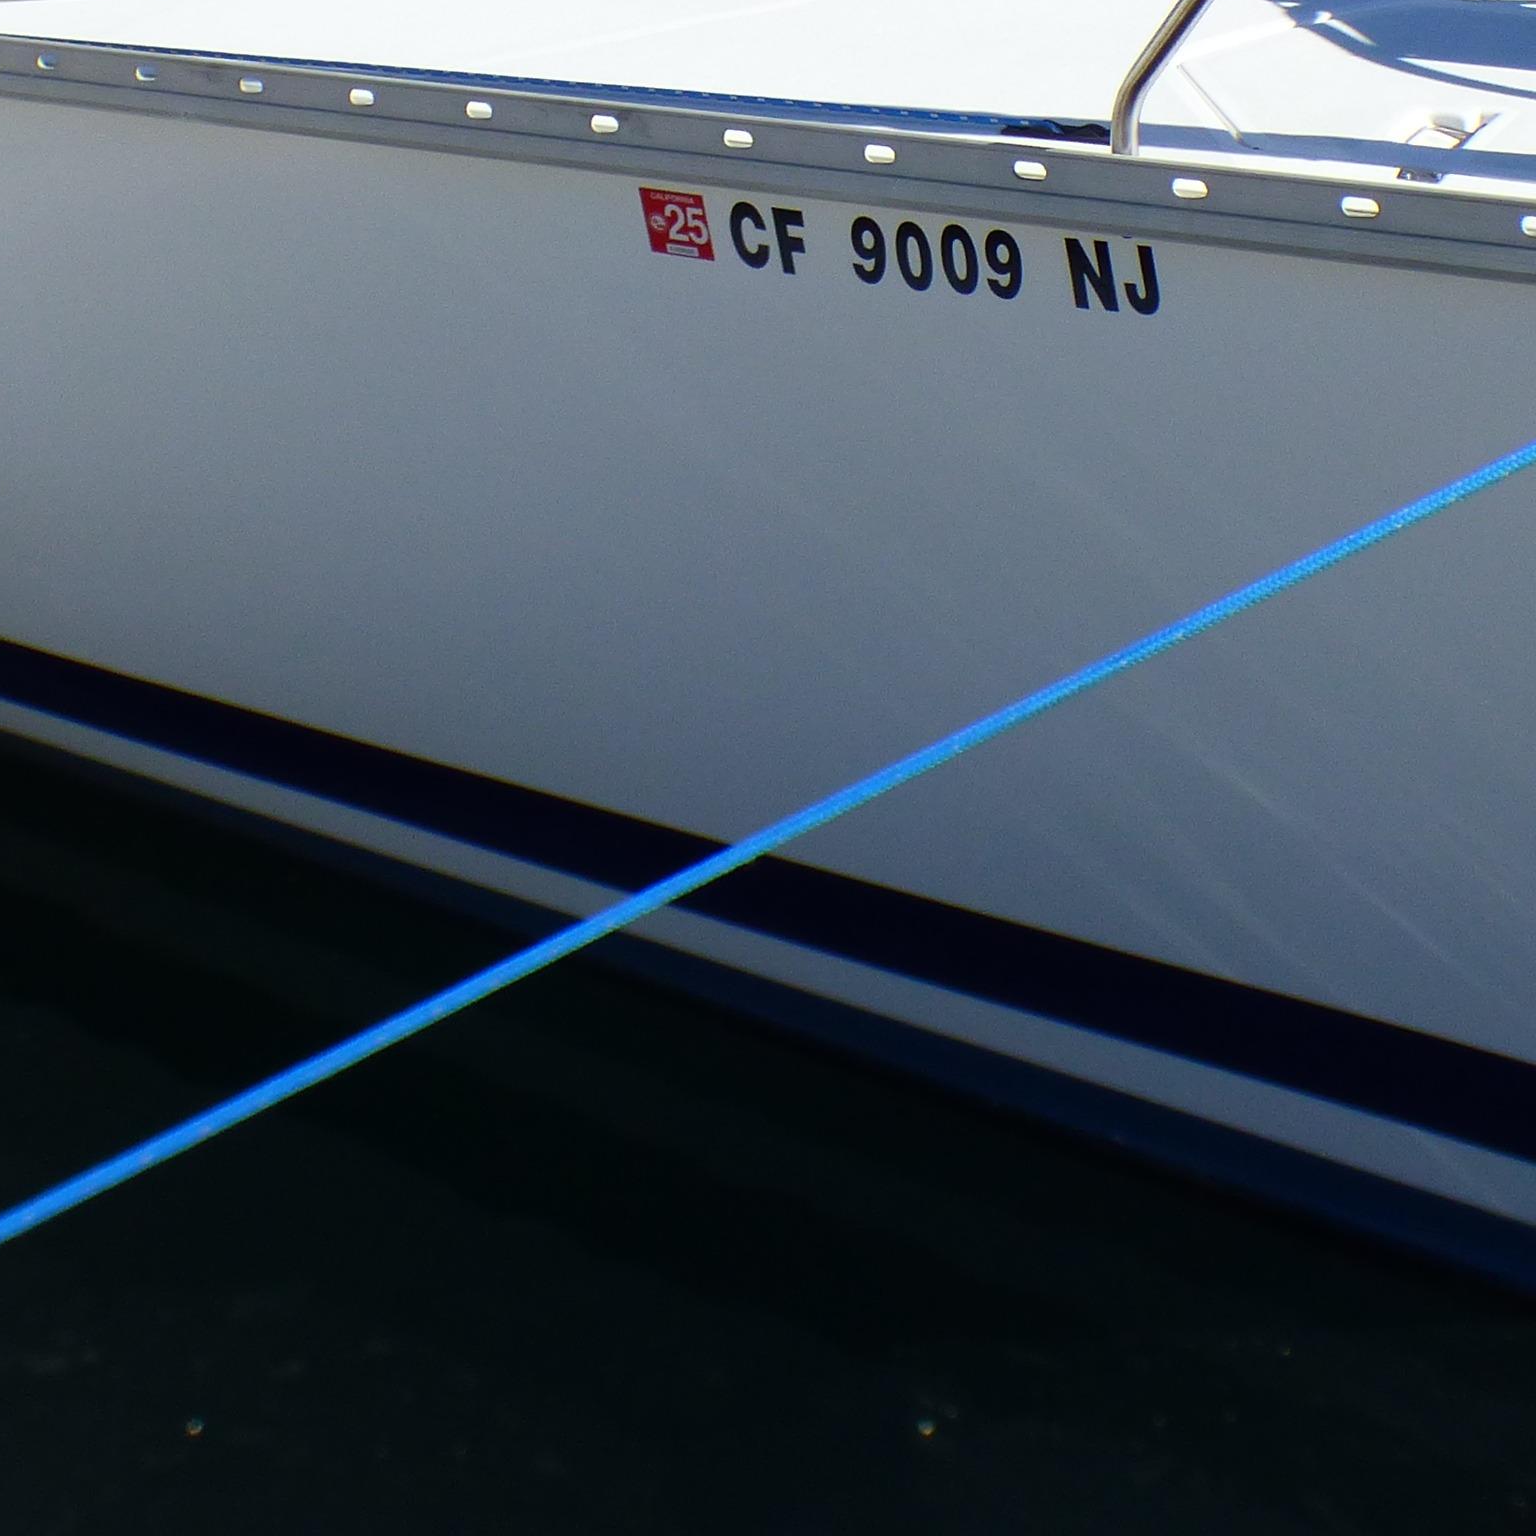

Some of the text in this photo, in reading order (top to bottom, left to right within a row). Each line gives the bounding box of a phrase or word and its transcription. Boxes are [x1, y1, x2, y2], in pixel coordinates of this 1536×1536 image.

[664, 203, 709, 245] 25
[729, 200, 1161, 316] CF 9009 NJ
